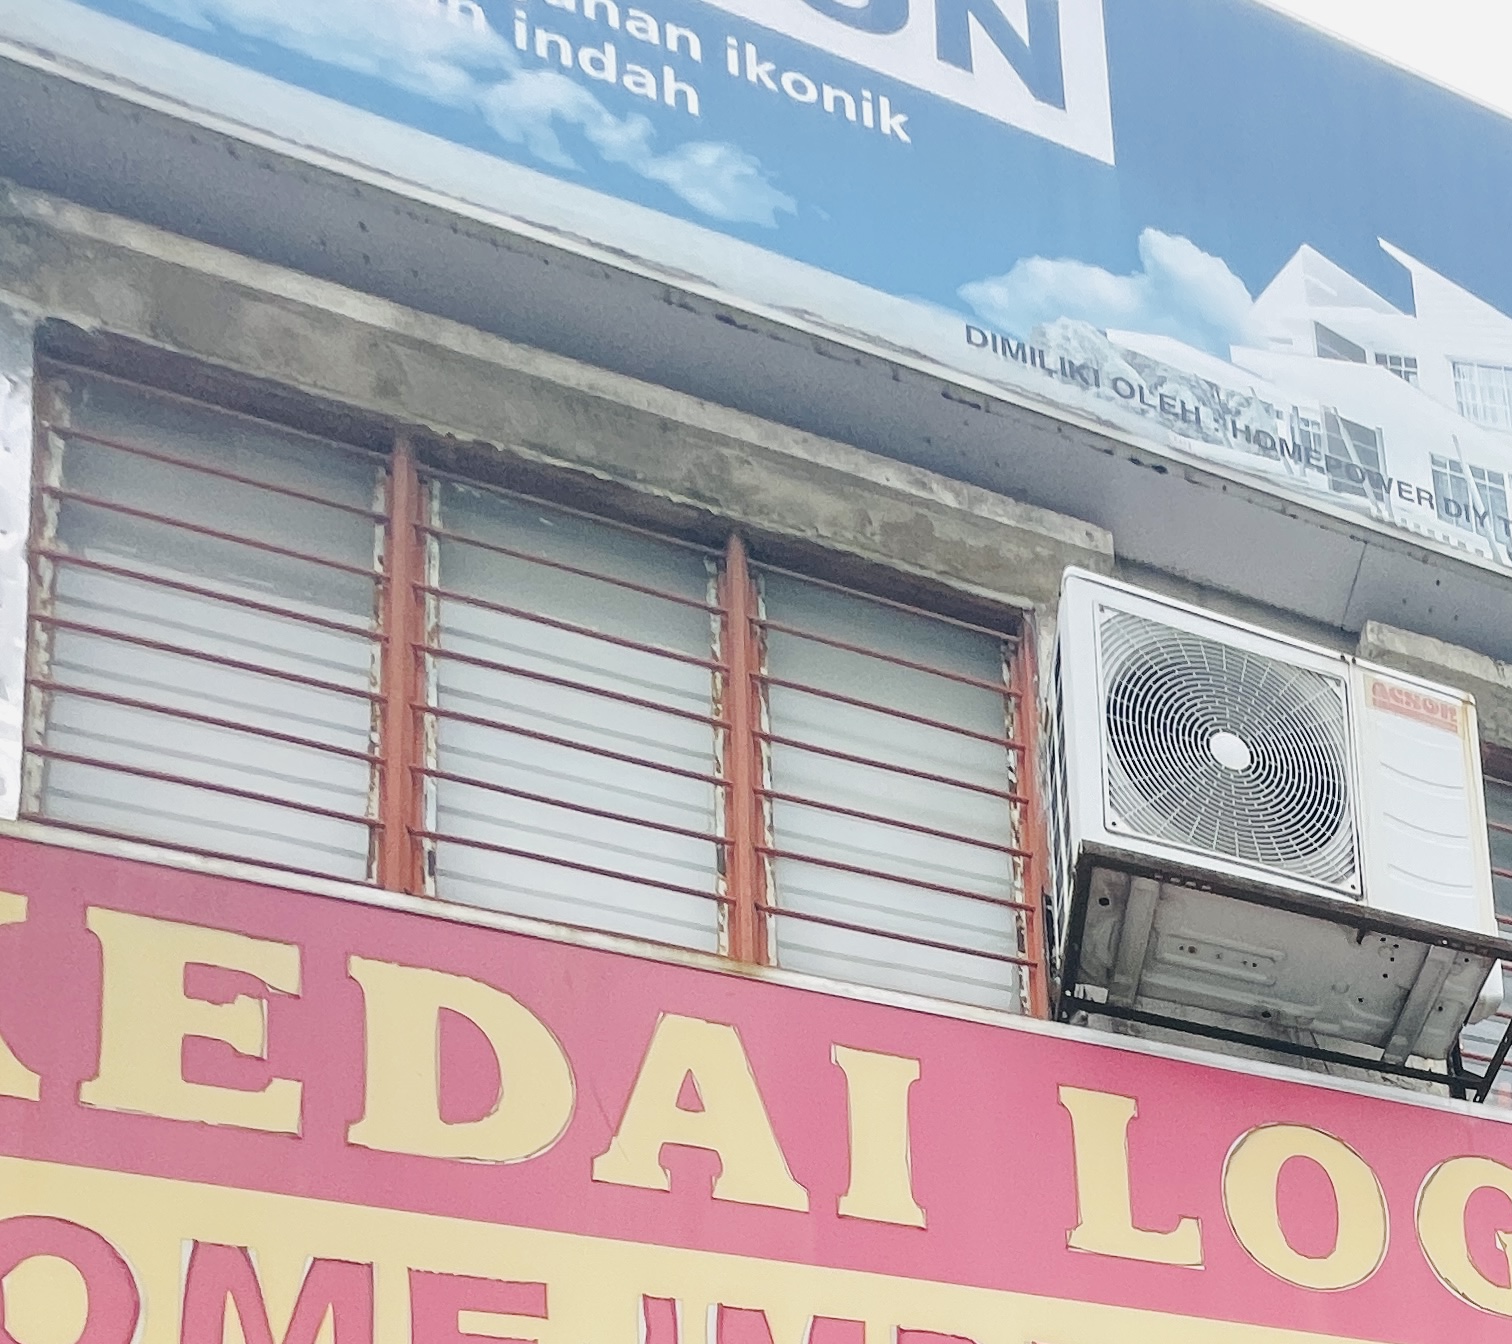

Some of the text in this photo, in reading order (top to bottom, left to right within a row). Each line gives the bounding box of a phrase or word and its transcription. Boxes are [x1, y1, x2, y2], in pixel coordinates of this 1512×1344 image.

[513, 9, 700, 117] indah
[725, 35, 912, 144] ikonik
[965, 323, 1101, 389] DIMILIKI
[1112, 376, 1201, 427] OLEH
[1230, 417, 1436, 511] HOMEPOWER
[1444, 495, 1490, 529] DIY
